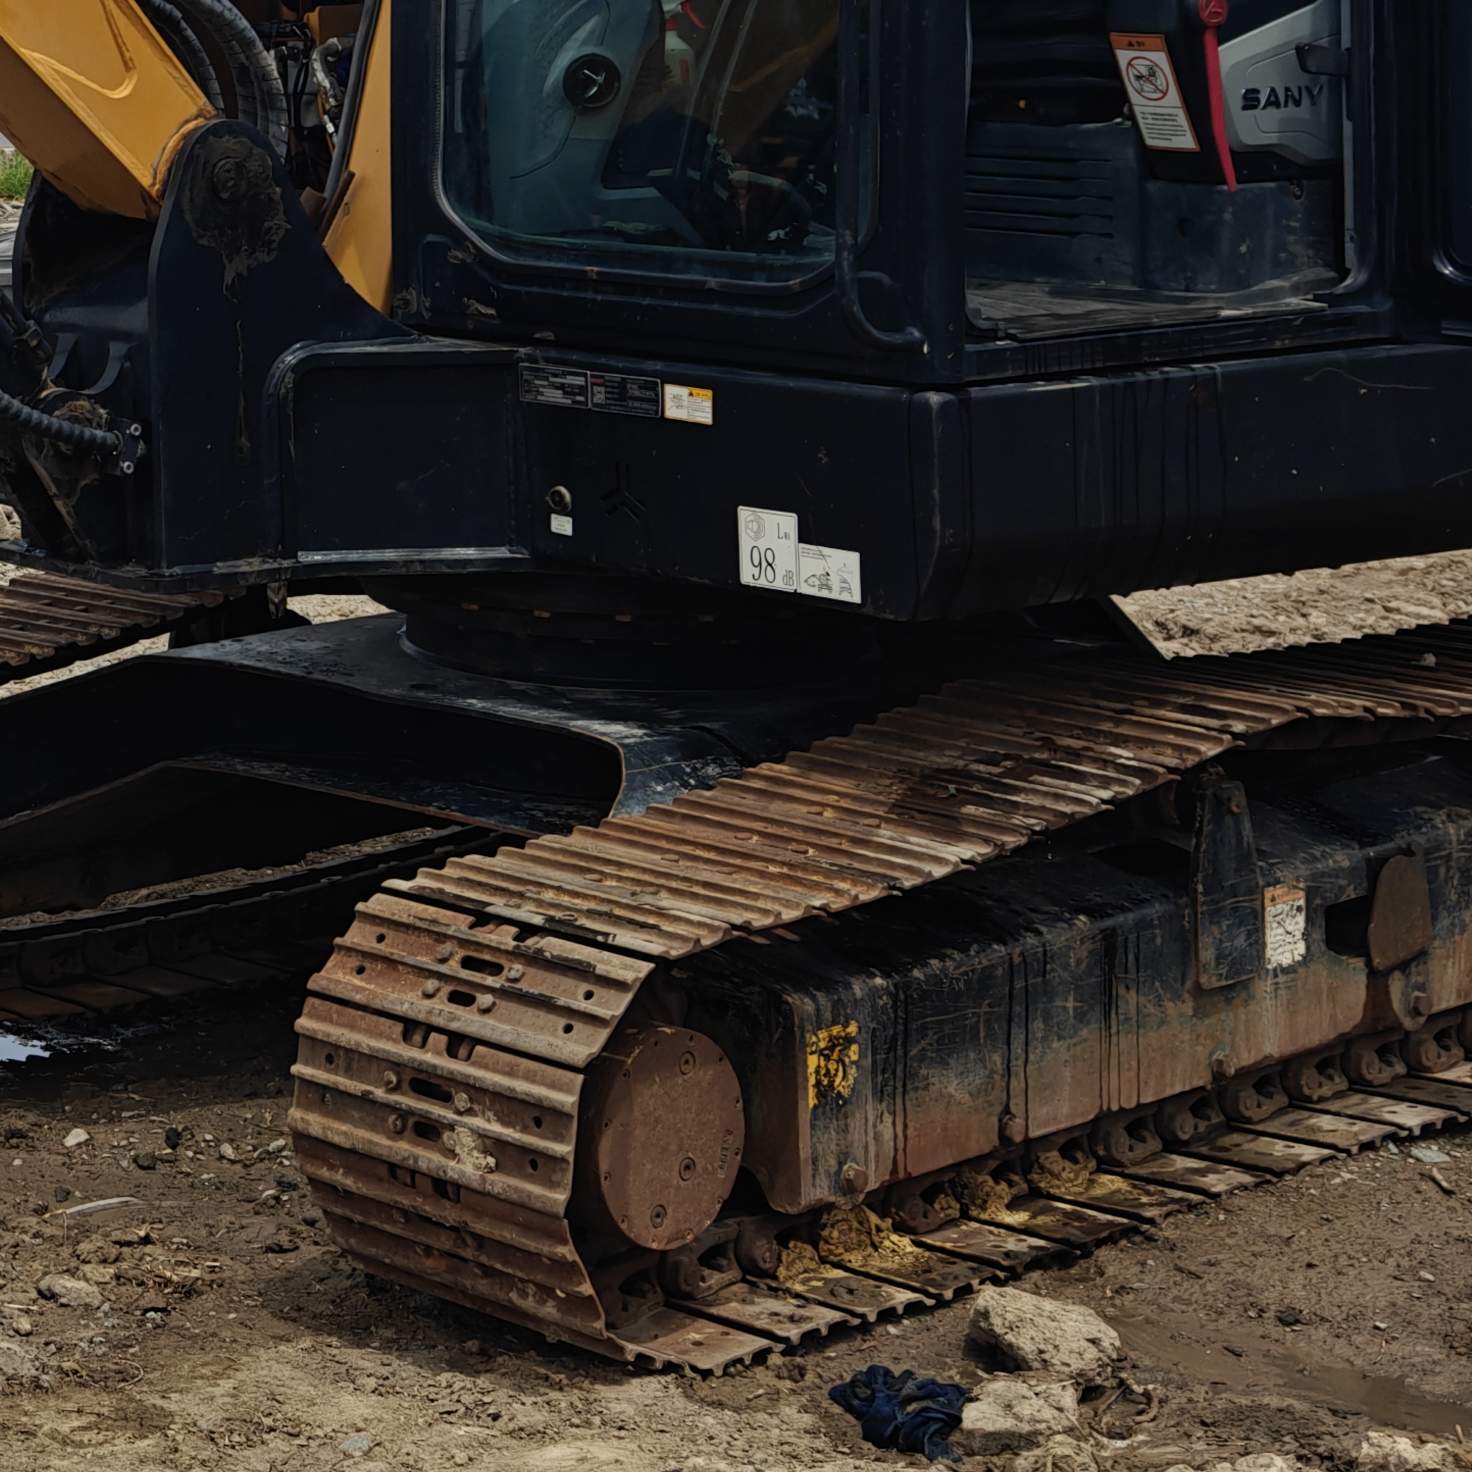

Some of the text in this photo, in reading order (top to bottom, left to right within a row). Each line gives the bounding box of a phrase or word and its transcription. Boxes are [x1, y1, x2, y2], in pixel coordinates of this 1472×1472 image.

[1241, 84, 1323, 111] SANY
[750, 545, 776, 584] 98
[782, 569, 794, 587] dB
